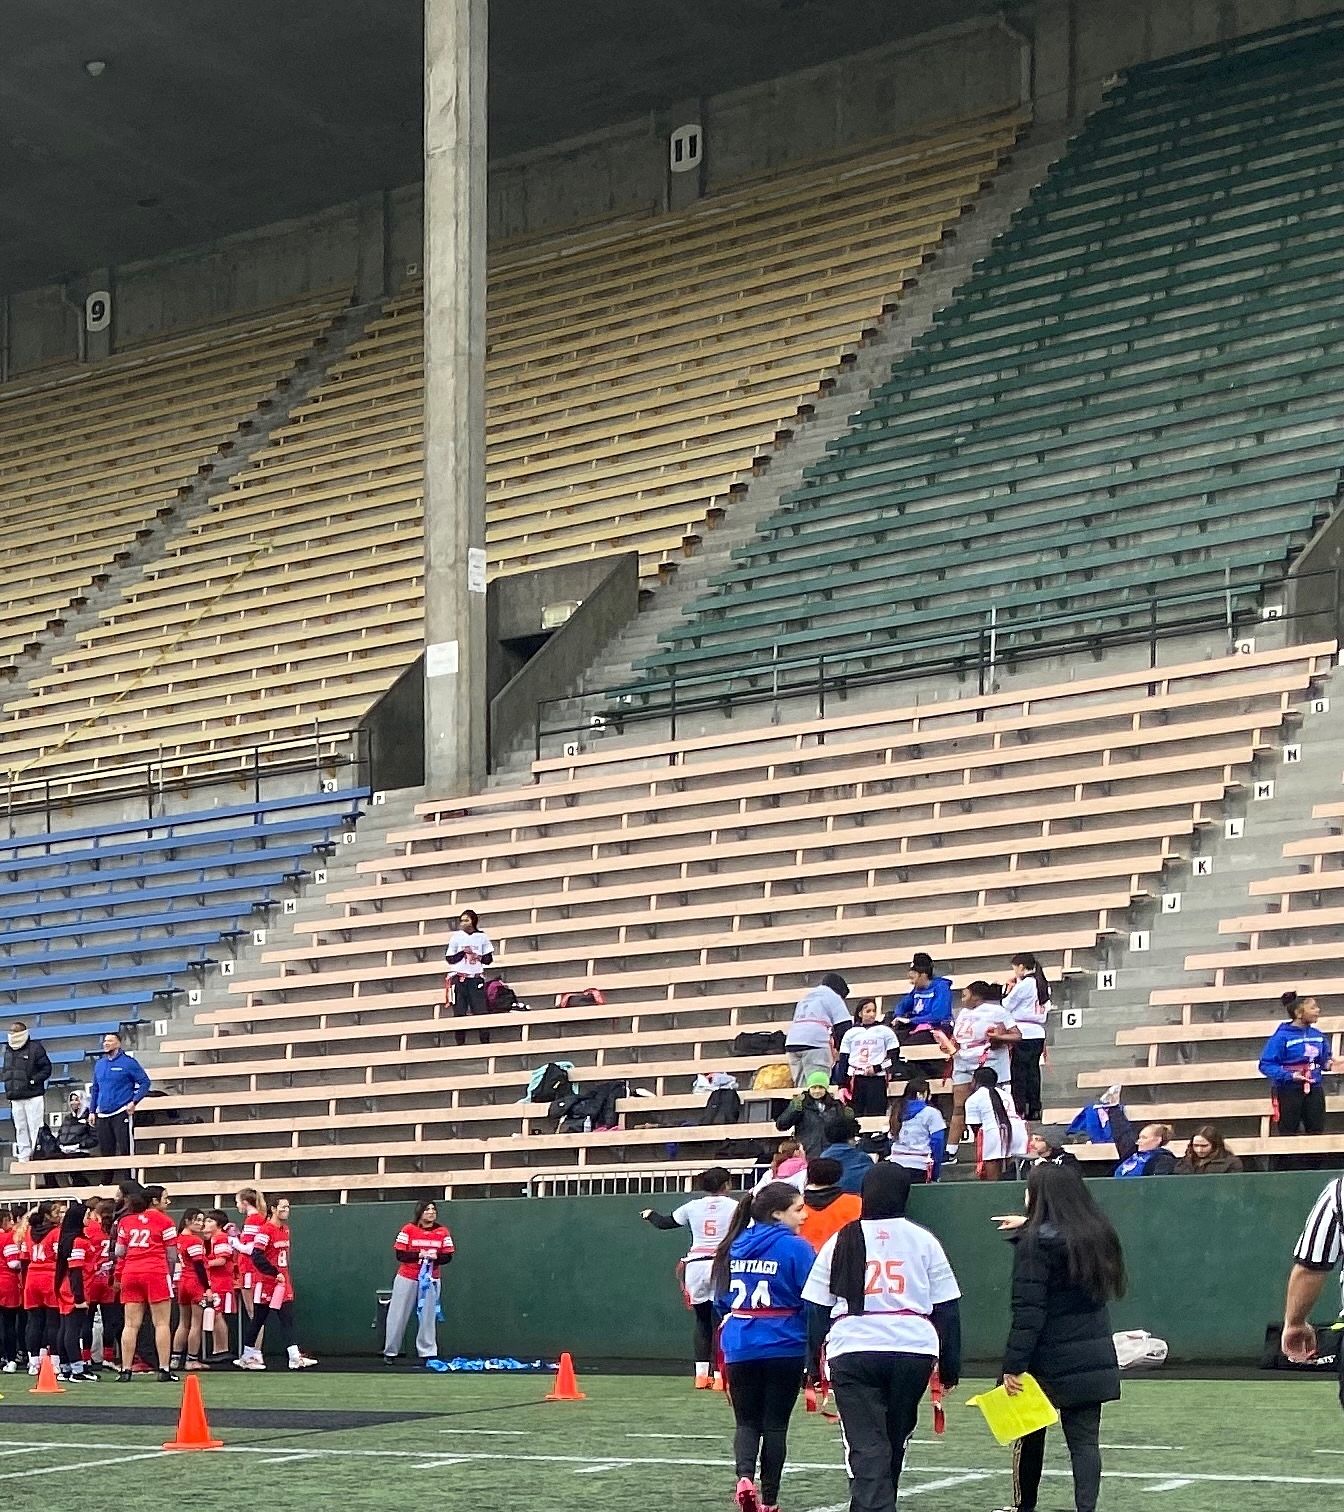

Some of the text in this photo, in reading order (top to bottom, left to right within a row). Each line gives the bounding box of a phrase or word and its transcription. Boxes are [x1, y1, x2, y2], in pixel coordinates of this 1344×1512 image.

[91, 300, 104, 321] 9
[1287, 749, 1297, 761] N
[1258, 784, 1270, 797] M
[1230, 823, 1240, 836] L
[1198, 860, 1207, 873] K
[1167, 896, 1176, 910] J
[1103, 975, 1113, 988] H
[1067, 1013, 1077, 1026] G
[52, 1114, 59, 1126] F
[704, 1219, 716, 1236] 6
[129, 1228, 151, 1248] 22
[730, 1259, 779, 1275] SANTIAGO
[865, 1260, 906, 1295] 25
[730, 1279, 771, 1310] 24
